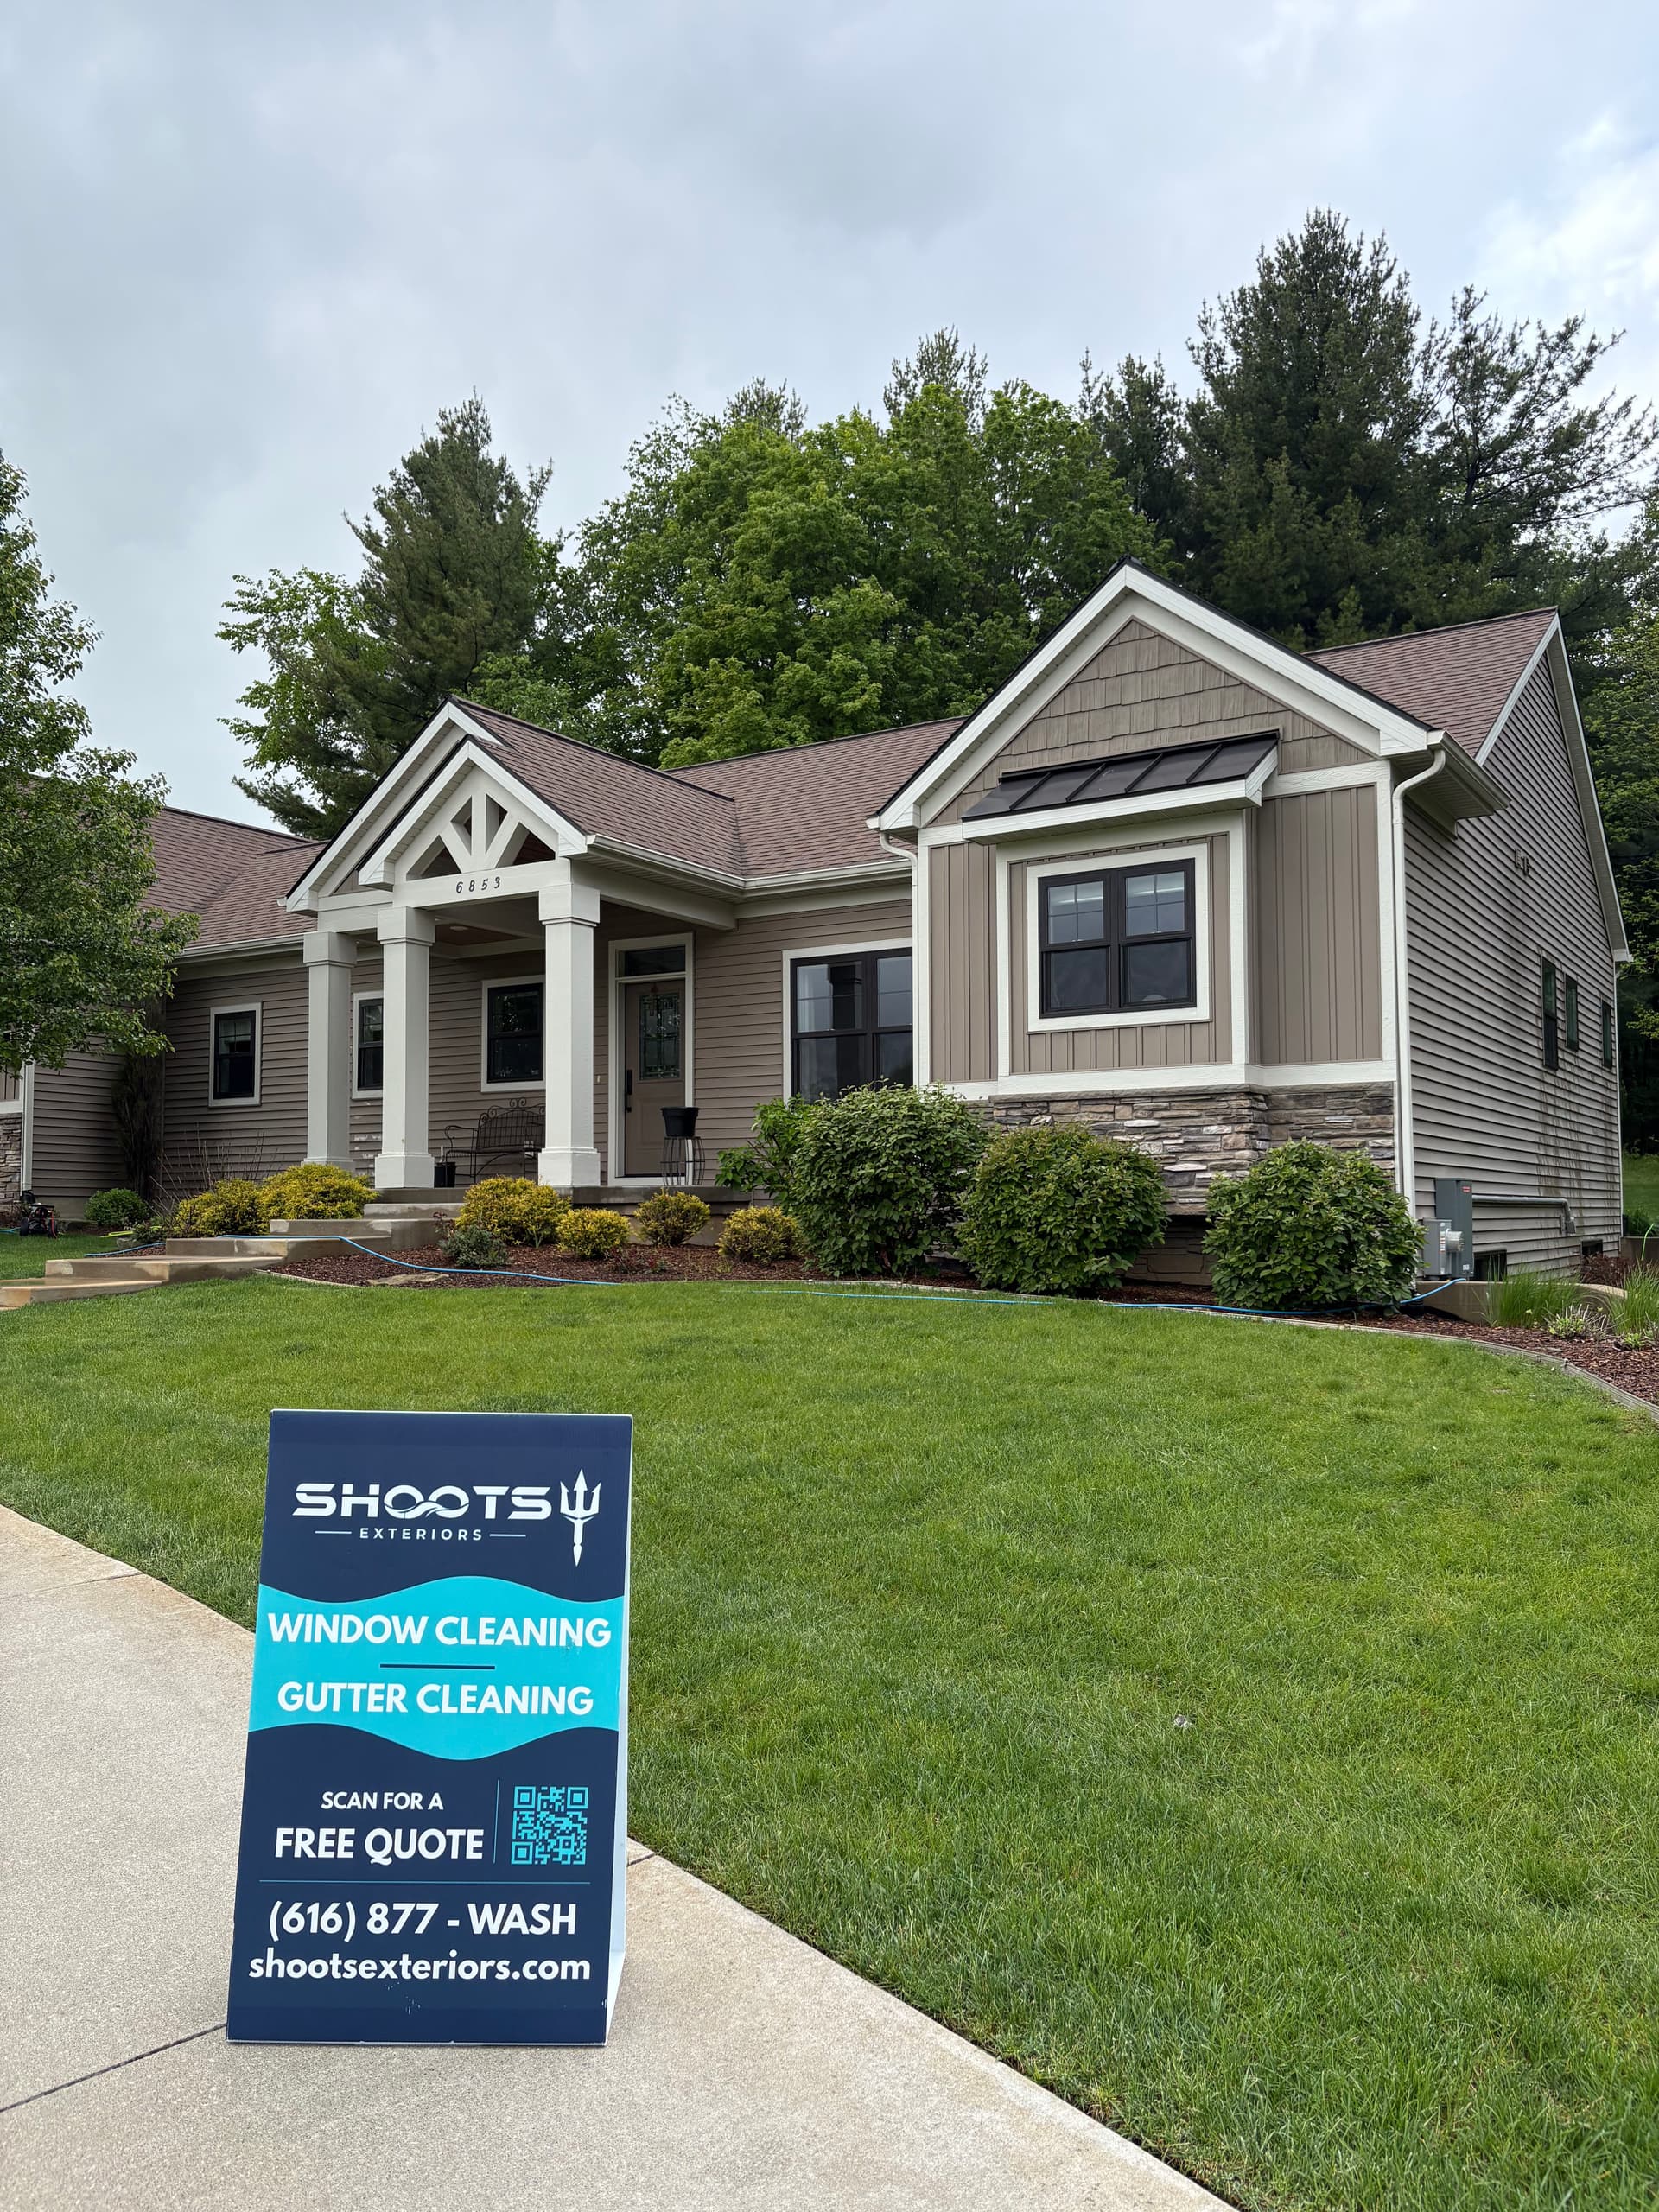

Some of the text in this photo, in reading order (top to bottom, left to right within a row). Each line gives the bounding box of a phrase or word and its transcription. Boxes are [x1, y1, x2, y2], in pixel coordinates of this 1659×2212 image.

[456, 876, 500, 893] 6853
[292, 1483, 552, 1520] SHOOTS
[359, 1528, 483, 1541] EXTERIORS
[268, 1612, 611, 1648] WINDOW CLEANING
[277, 1681, 594, 1715] GUTTER CLEANING
[321, 1791, 444, 1810] SCAN FOR A
[275, 1827, 484, 1866] FREE QUOTE
[269, 1901, 356, 1942] (616)
[366, 1902, 439, 1936] 877
[467, 1903, 576, 1936] WASH
[248, 1947, 591, 1980] shootsexteriors.com
